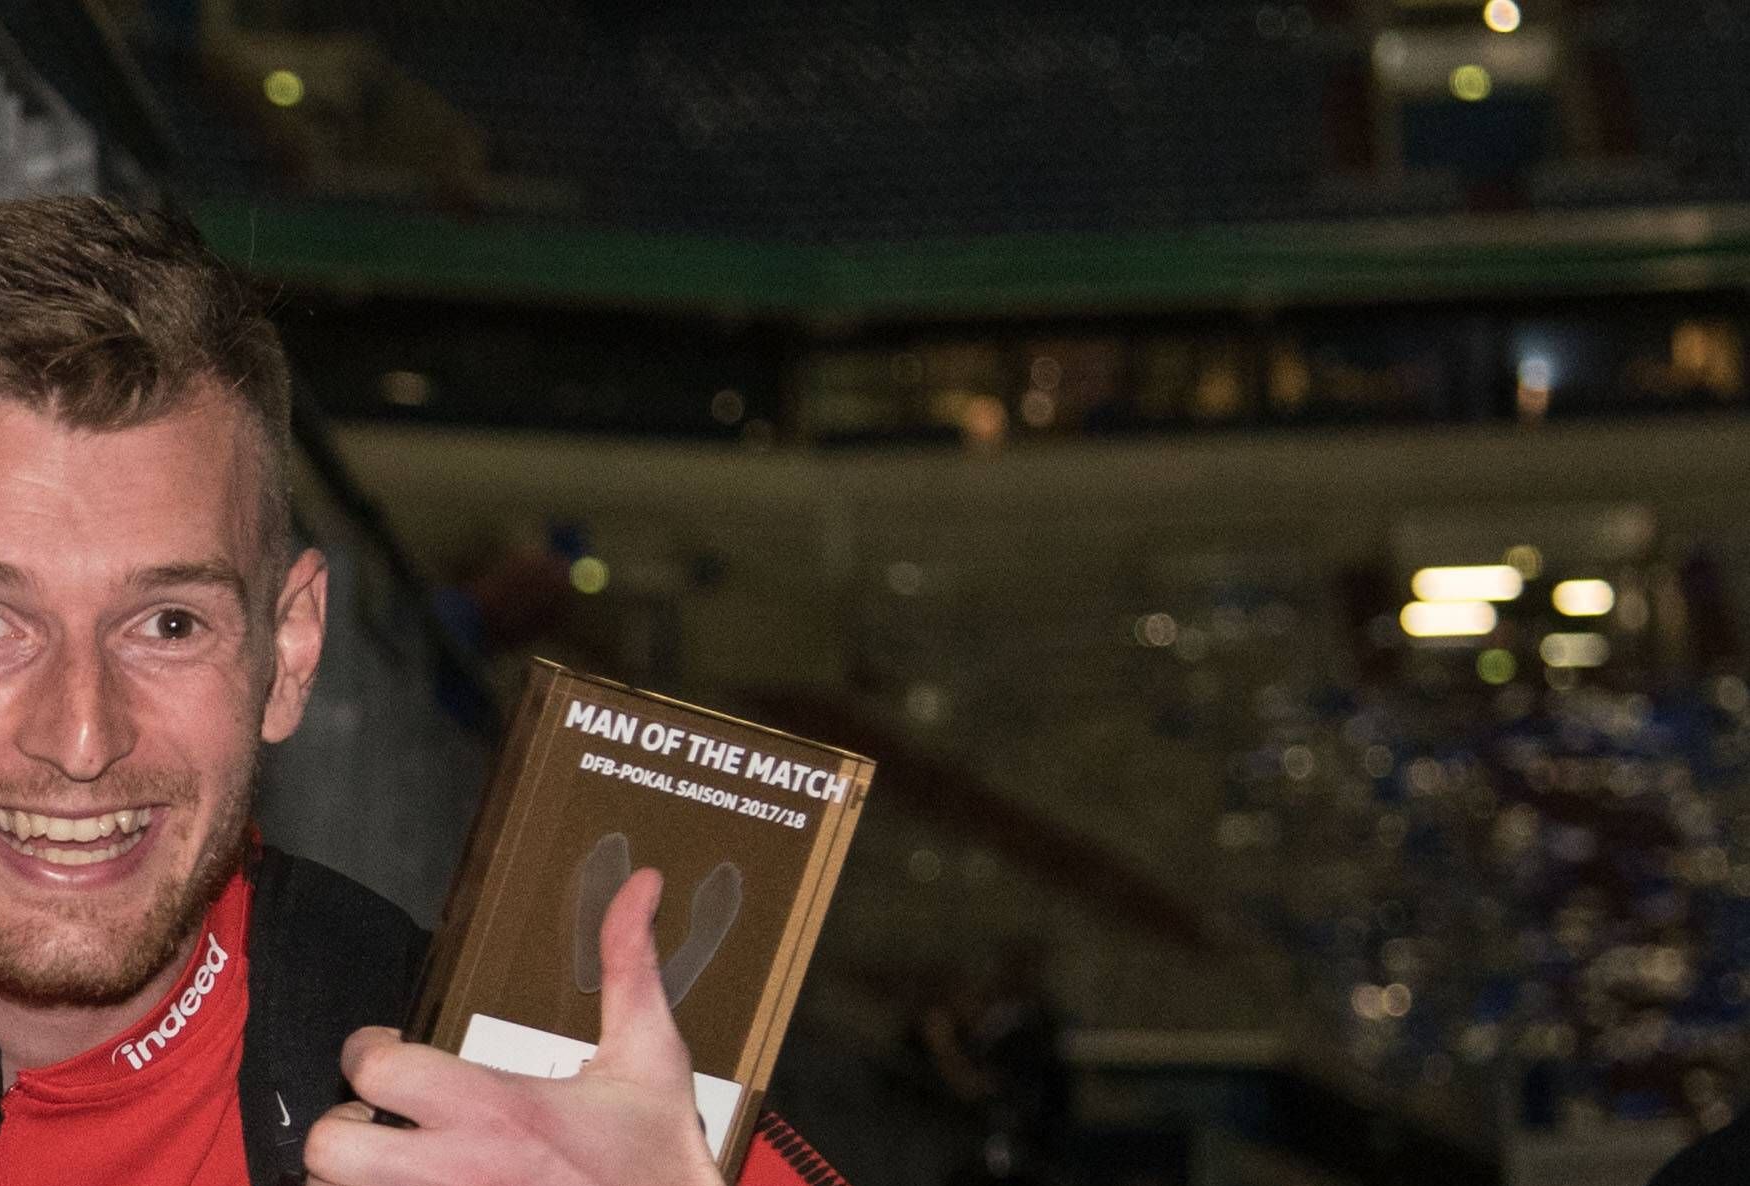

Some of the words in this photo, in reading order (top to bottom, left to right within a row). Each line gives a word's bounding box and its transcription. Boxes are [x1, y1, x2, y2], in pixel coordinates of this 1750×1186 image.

[565, 701, 638, 744] MAN
[641, 723, 684, 755] OF
[688, 734, 745, 774] THE
[746, 752, 849, 803] MATCH
[580, 753, 674, 793] DFB-POKAL
[675, 780, 738, 810] SAISON
[738, 797, 807, 829] 2017/18
[118, 932, 229, 1070] indeed
